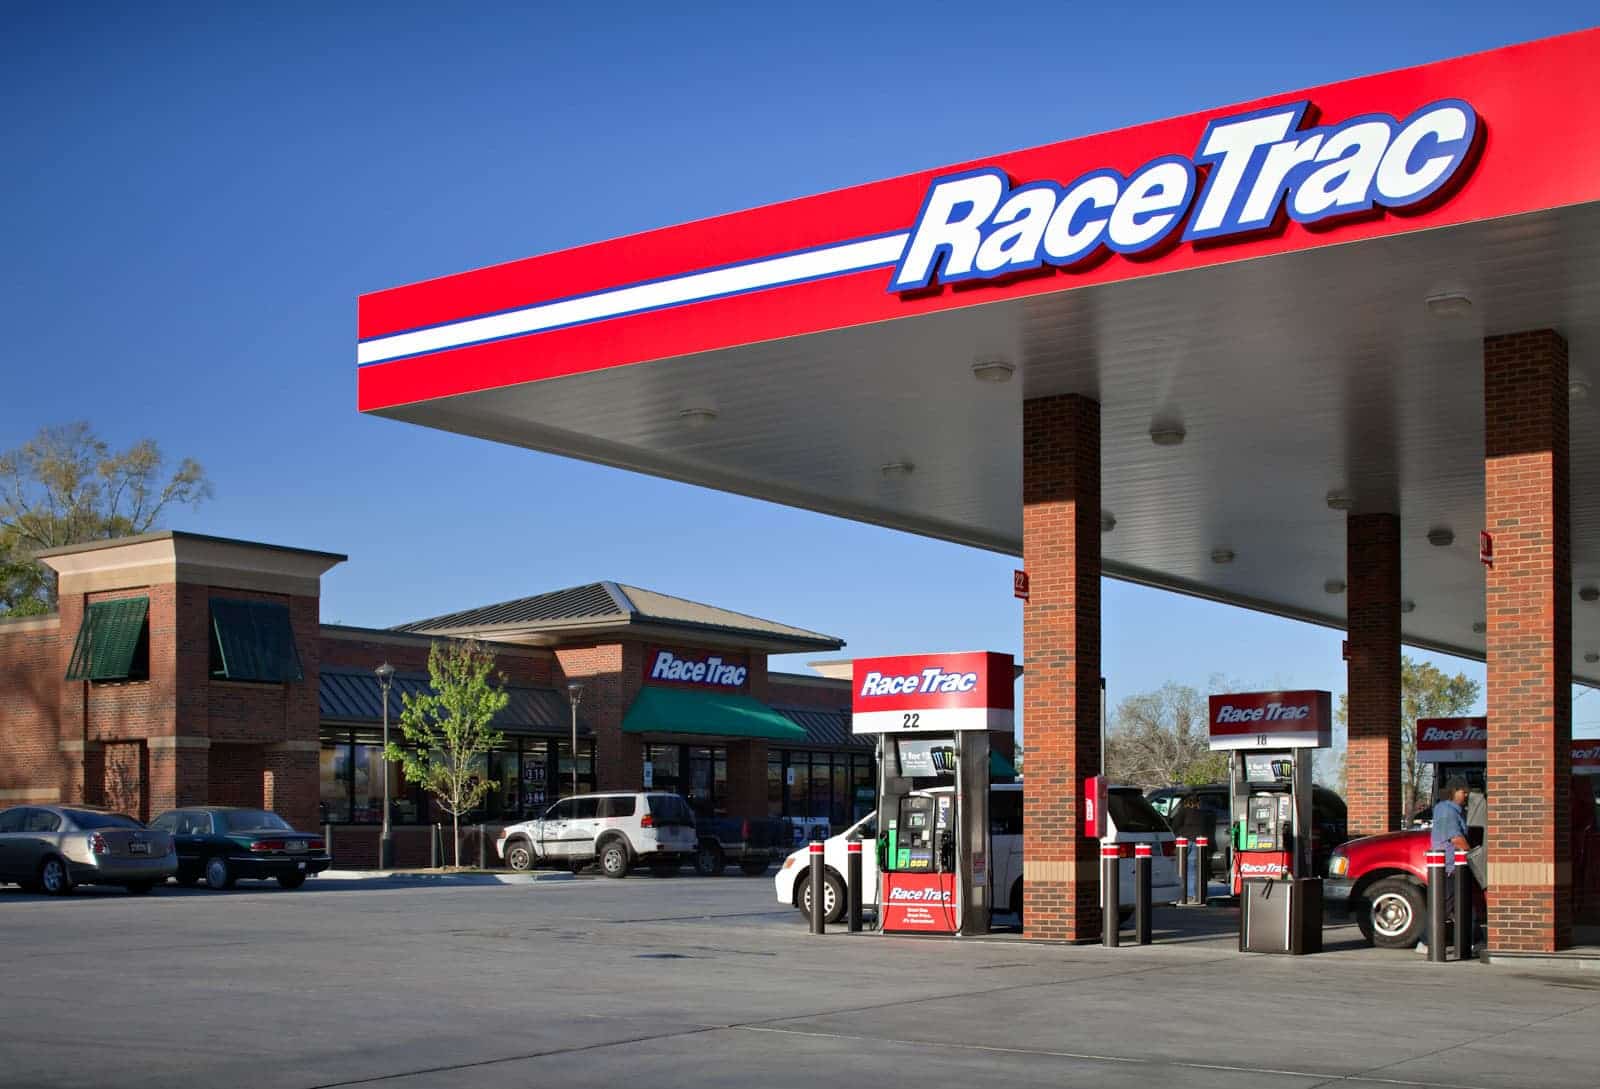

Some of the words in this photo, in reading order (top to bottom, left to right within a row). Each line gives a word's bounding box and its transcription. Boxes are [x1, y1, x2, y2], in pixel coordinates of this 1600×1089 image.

[890, 100, 1474, 290] RaceTrac
[651, 650, 747, 686] RaceTrac
[860, 668, 977, 697] RaceTrac
[903, 713, 920, 728] 22
[1215, 703, 1310, 723] RaceTrac
[1256, 735, 1267, 745] 18
[1422, 725, 1487, 741] RaceTra
[890, 888, 951, 901] RaceTrac
